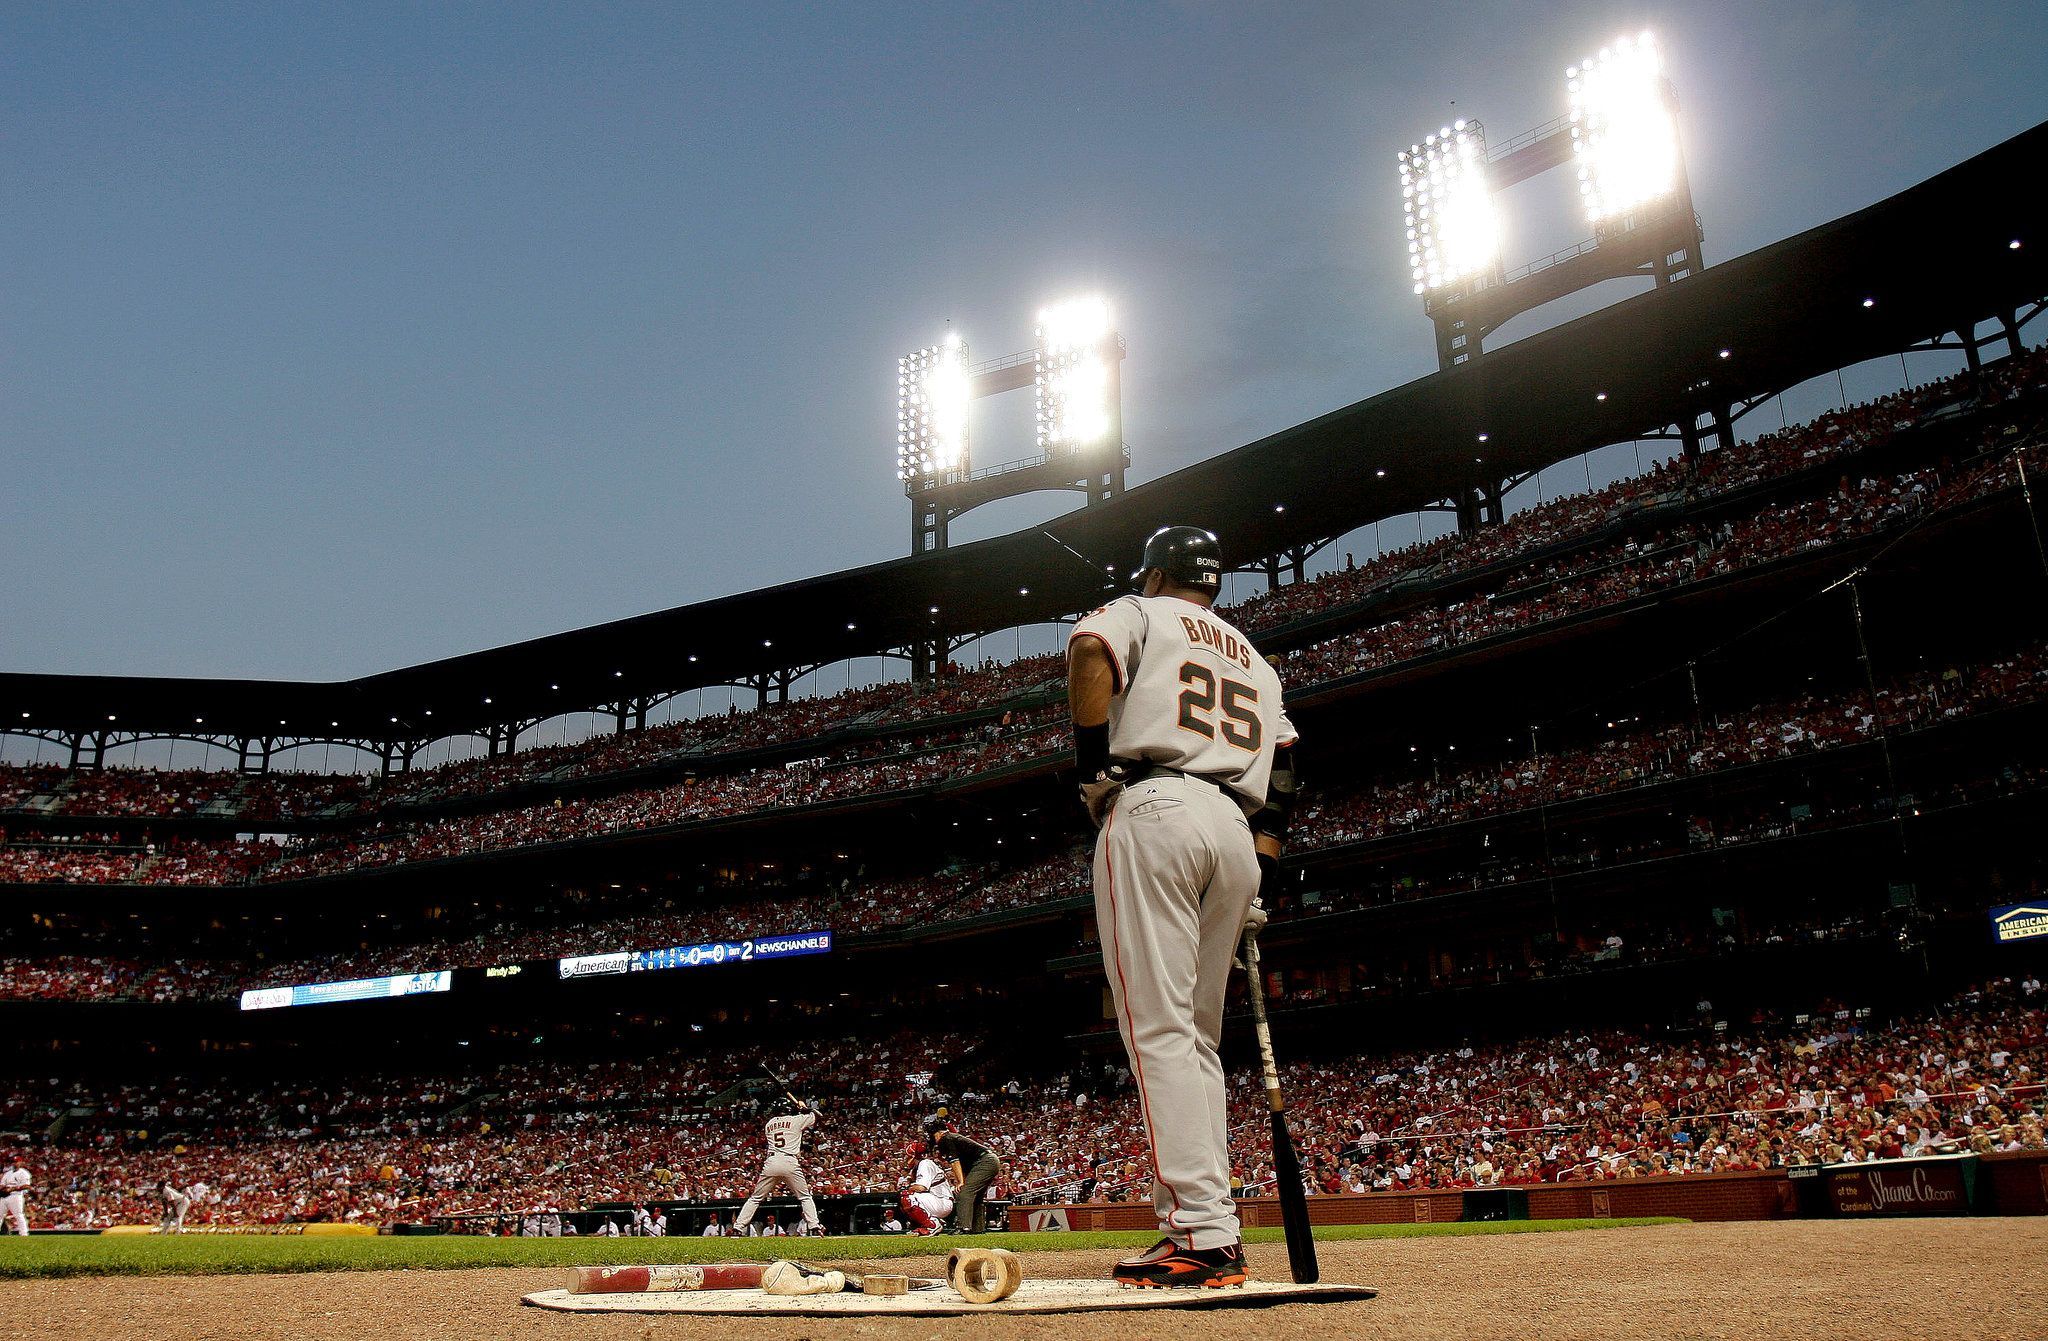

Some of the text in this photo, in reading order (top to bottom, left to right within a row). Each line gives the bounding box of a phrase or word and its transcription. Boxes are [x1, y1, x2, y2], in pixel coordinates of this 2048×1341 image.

[1196, 557, 1220, 569] BONDS
[1180, 616, 1251, 669] BONDS
[1178, 661, 1262, 755] 25
[1999, 916, 2048, 931] AMERICAN
[741, 941, 753, 960] 2
[755, 938, 819, 953] NEWSCHANNEL
[561, 958, 627, 977] American
[774, 1132, 786, 1148] 5
[1868, 1171, 1916, 1210] Shane
